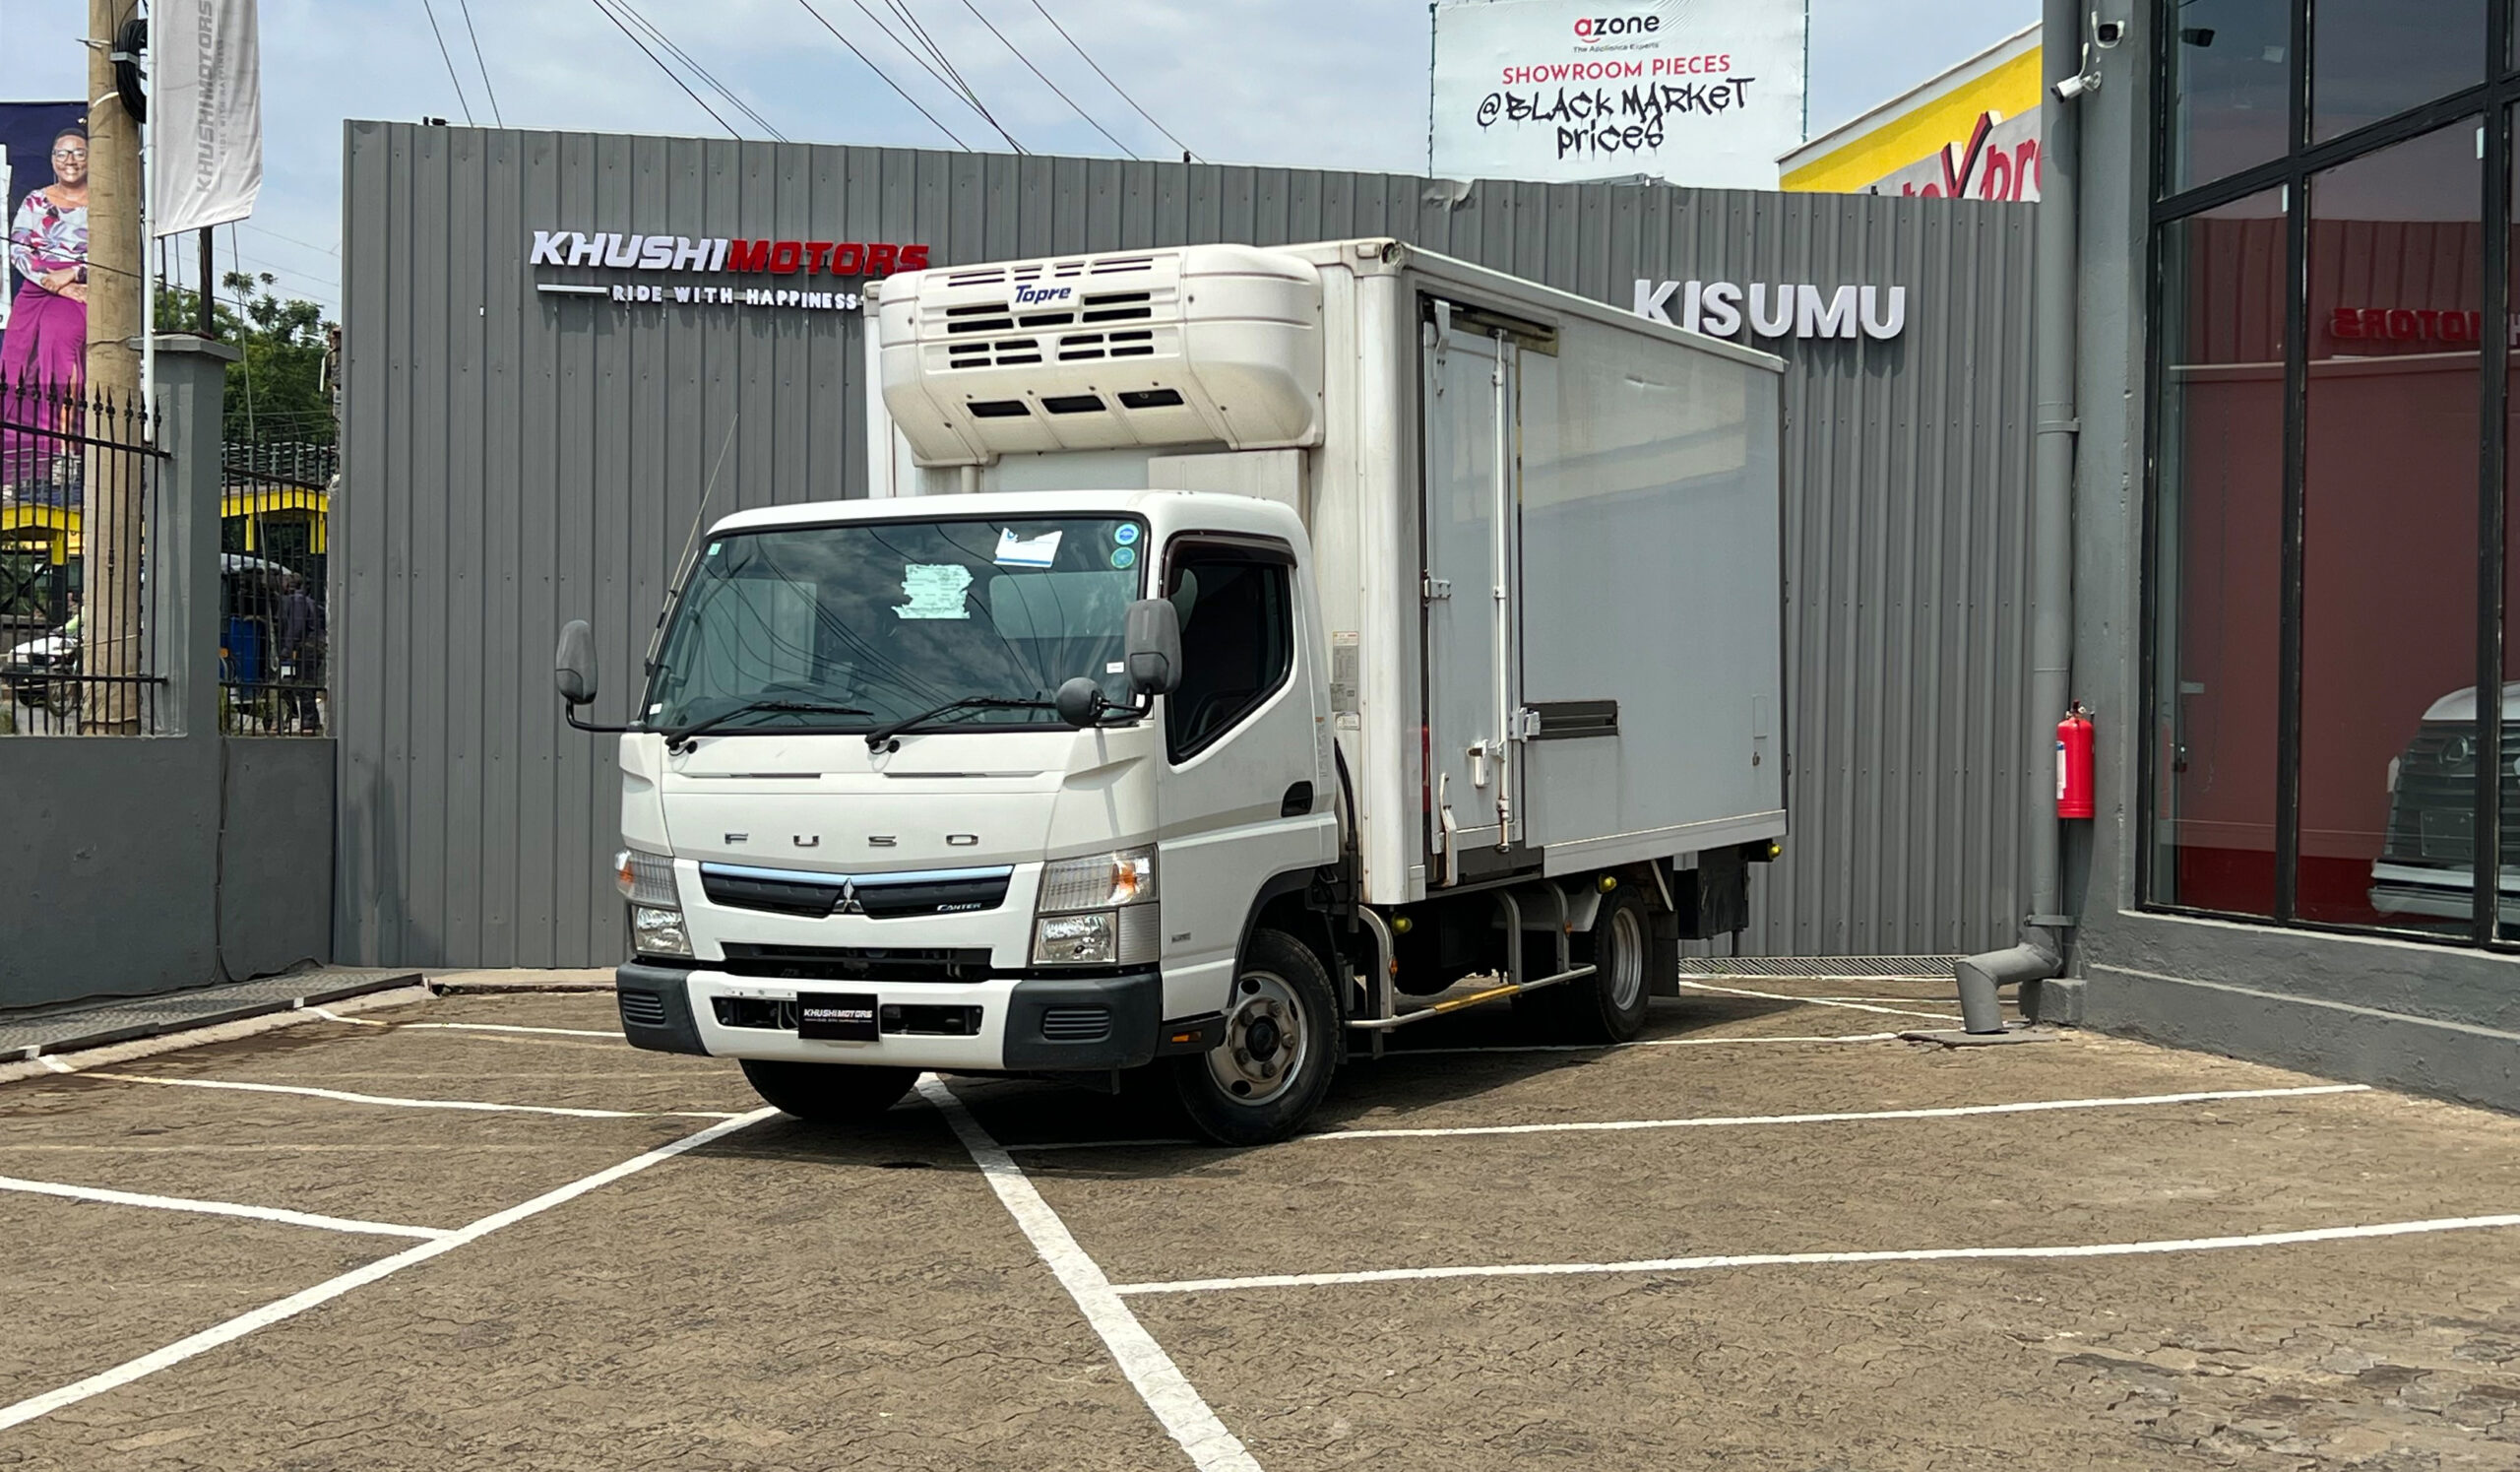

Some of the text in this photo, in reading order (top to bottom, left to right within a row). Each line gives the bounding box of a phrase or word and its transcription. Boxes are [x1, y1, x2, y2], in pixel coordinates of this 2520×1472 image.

[1574, 15, 1660, 36] azone
[1502, 54, 1731, 85] SHOWROOM PIECES
[1557, 115, 1665, 160] prices
[612, 285, 857, 310] RIDE WITH HAPPINESS
[1015, 285, 1072, 304] Topre
[1634, 279, 1906, 340] KISUMU
[724, 833, 978, 847] FUSO
